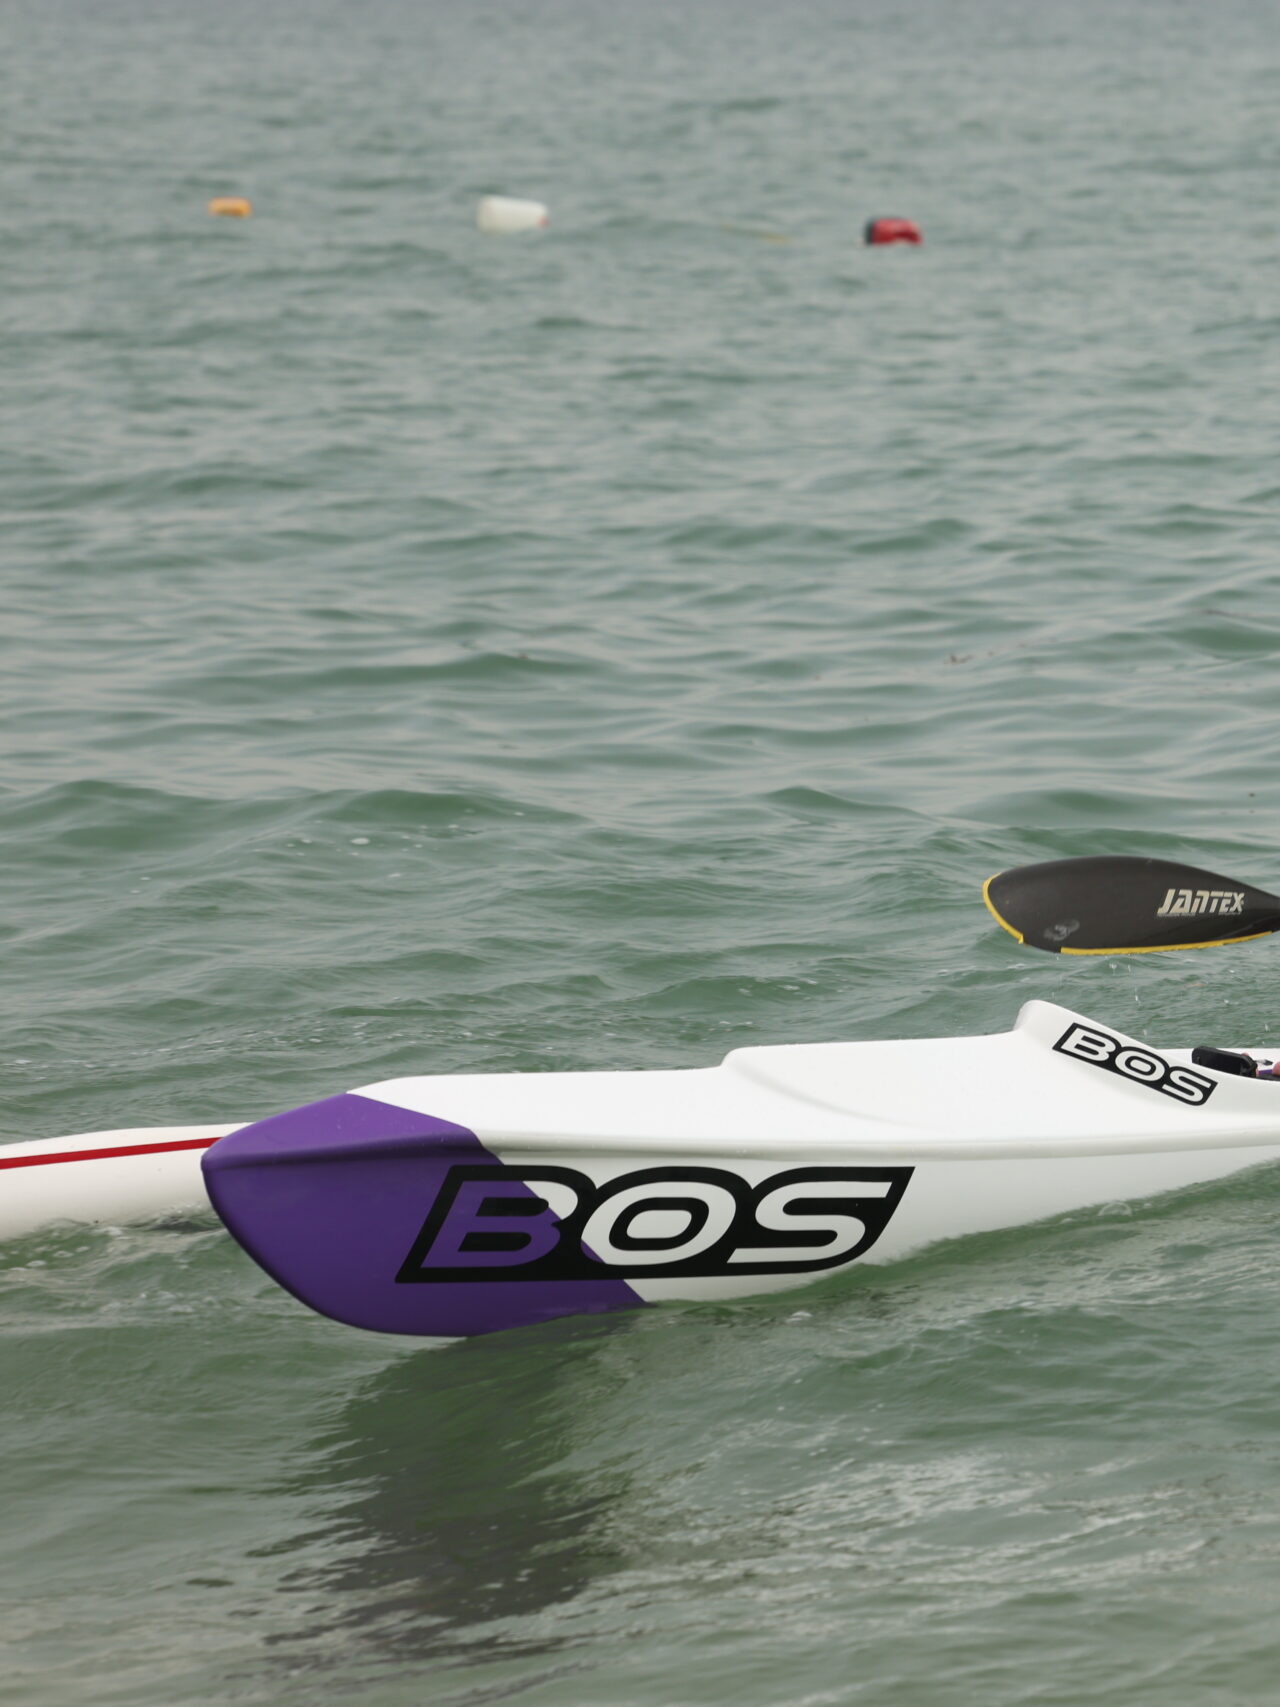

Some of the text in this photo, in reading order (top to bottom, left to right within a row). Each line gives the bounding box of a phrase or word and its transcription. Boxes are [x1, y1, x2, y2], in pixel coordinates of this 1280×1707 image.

[1157, 888, 1245, 914] JANTEX
[1052, 1022, 1218, 1106] BOS
[395, 1165, 915, 1283] BOS
